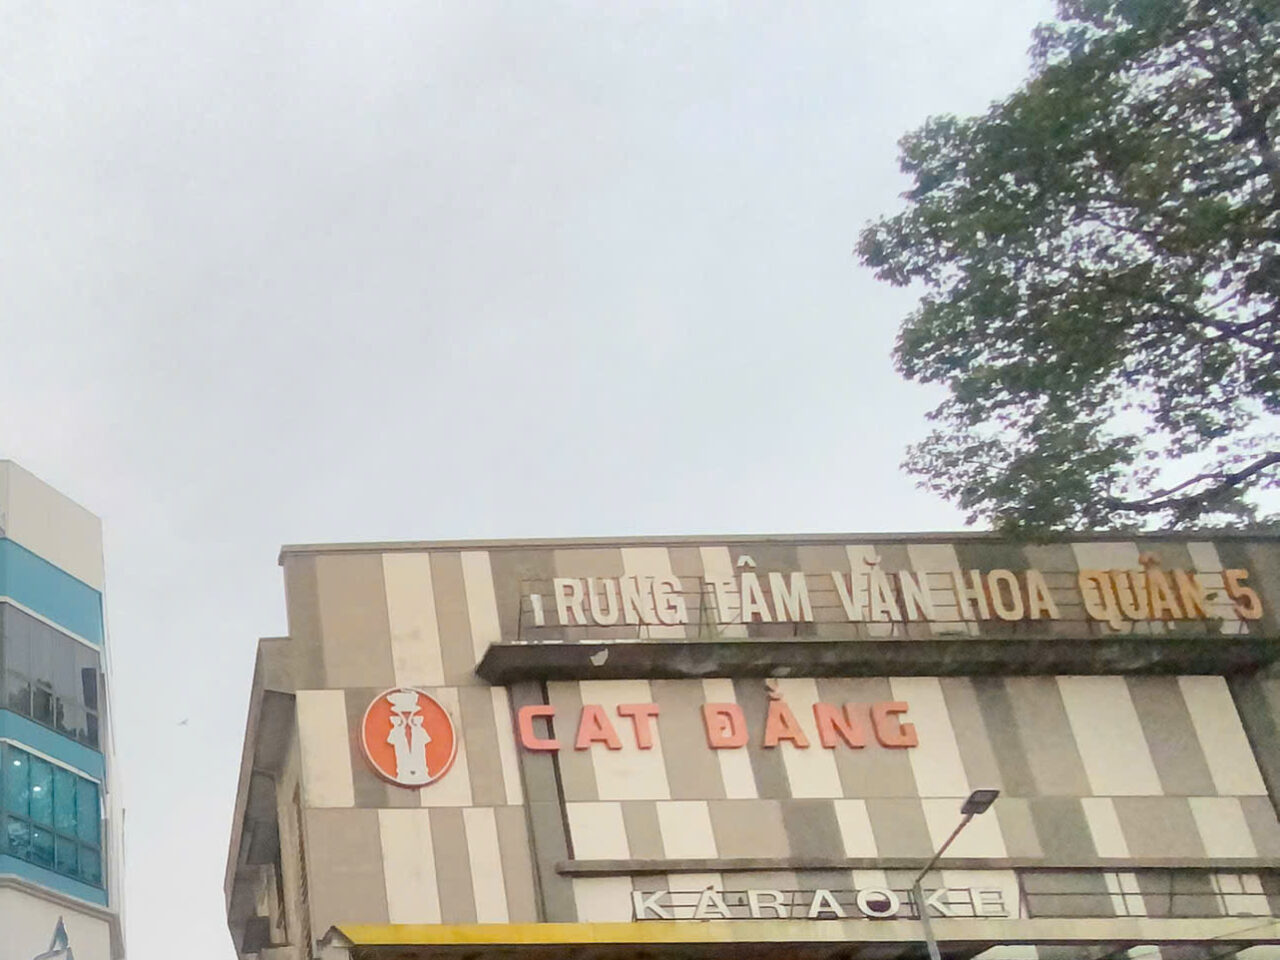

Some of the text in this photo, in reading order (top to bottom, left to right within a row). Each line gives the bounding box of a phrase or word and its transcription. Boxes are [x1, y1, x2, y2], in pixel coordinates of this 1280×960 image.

[705, 555, 814, 625] TÂM
[831, 554, 931, 623] VĂN
[1223, 568, 1263, 621] 5
[518, 703, 660, 752] CAT
